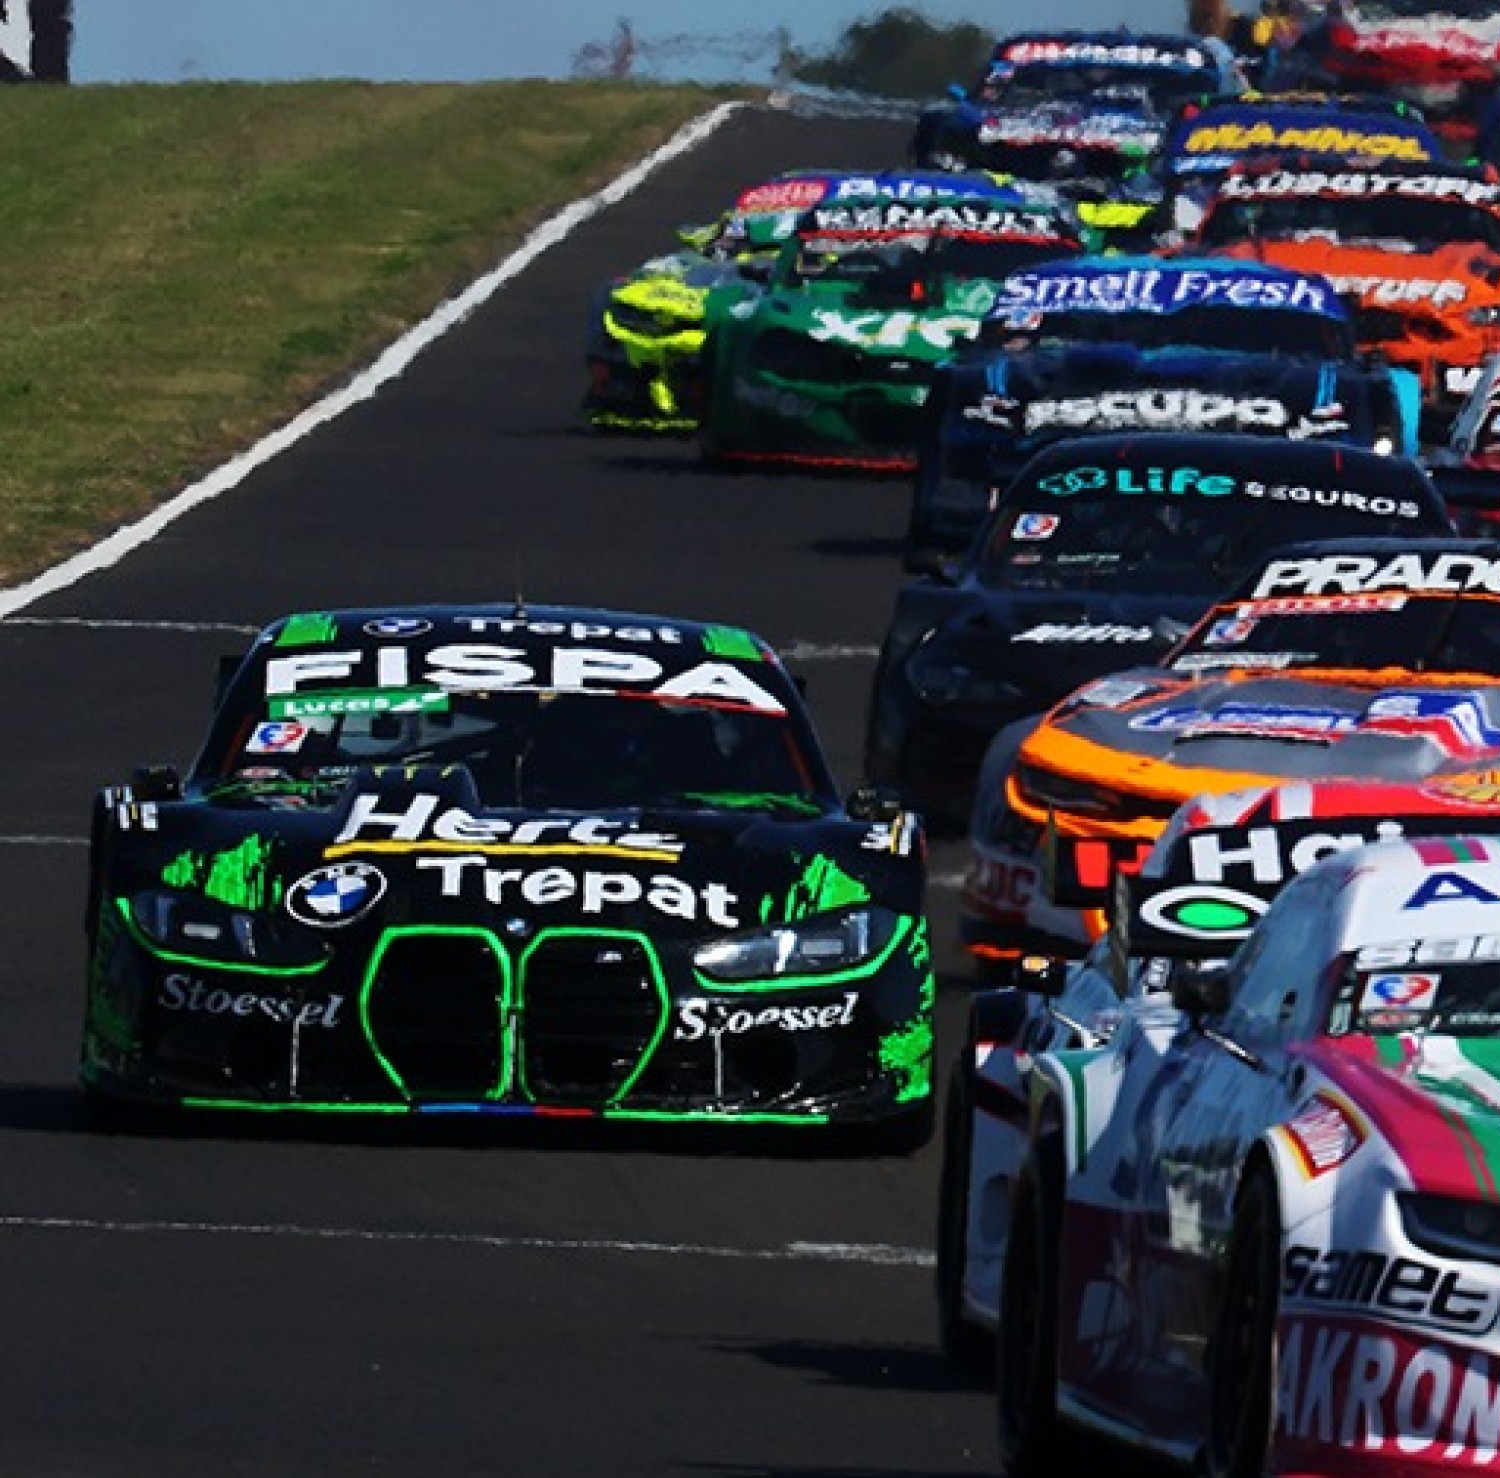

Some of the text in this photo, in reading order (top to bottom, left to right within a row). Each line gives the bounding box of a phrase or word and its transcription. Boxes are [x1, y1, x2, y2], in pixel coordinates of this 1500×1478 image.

[1184, 122, 1430, 160] MANNOL
[1003, 270, 1161, 303] Smell
[1174, 271, 1326, 310] Fresh
[1116, 466, 1236, 496] Life
[454, 616, 682, 644] Trepat
[266, 644, 788, 714] FISPA
[285, 698, 389, 715] Lucas
[334, 792, 686, 852] Hertz
[416, 854, 740, 928] Trepat
[1283, 1244, 1491, 1327] samet
